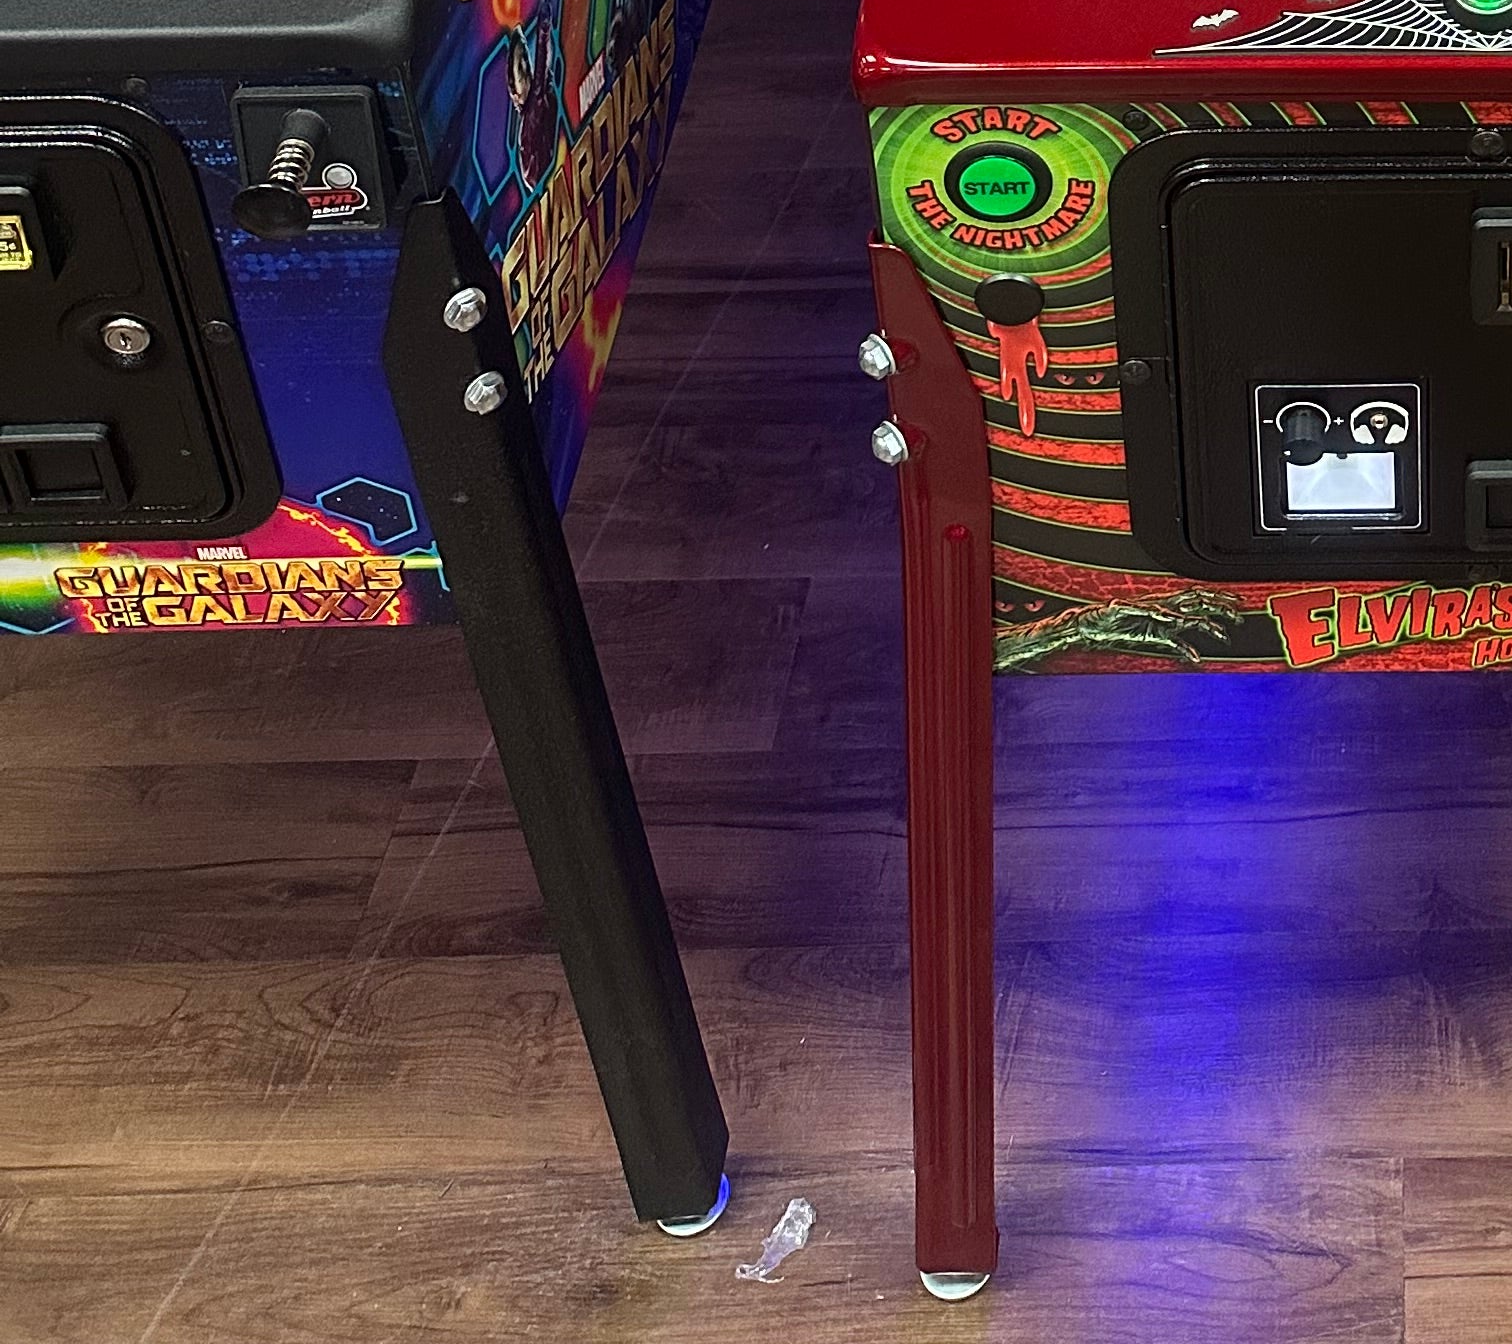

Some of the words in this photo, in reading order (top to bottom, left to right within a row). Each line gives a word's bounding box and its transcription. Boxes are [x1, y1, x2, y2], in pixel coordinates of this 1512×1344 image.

[579, 51, 605, 120] MARVEL
[931, 107, 1062, 142] START
[964, 182, 1030, 196] START
[551, 79, 670, 352] GALAXY
[907, 179, 957, 230] THE
[950, 178, 1096, 250] NIGHTMARE
[530, 289, 551, 348] OF
[525, 331, 555, 405] THE
[197, 546, 248, 561] MARVEL
[57, 561, 403, 601] GUARDIANS
[96, 611, 147, 628] THE
[107, 598, 139, 613] OF
[144, 590, 402, 626] GALAXY
